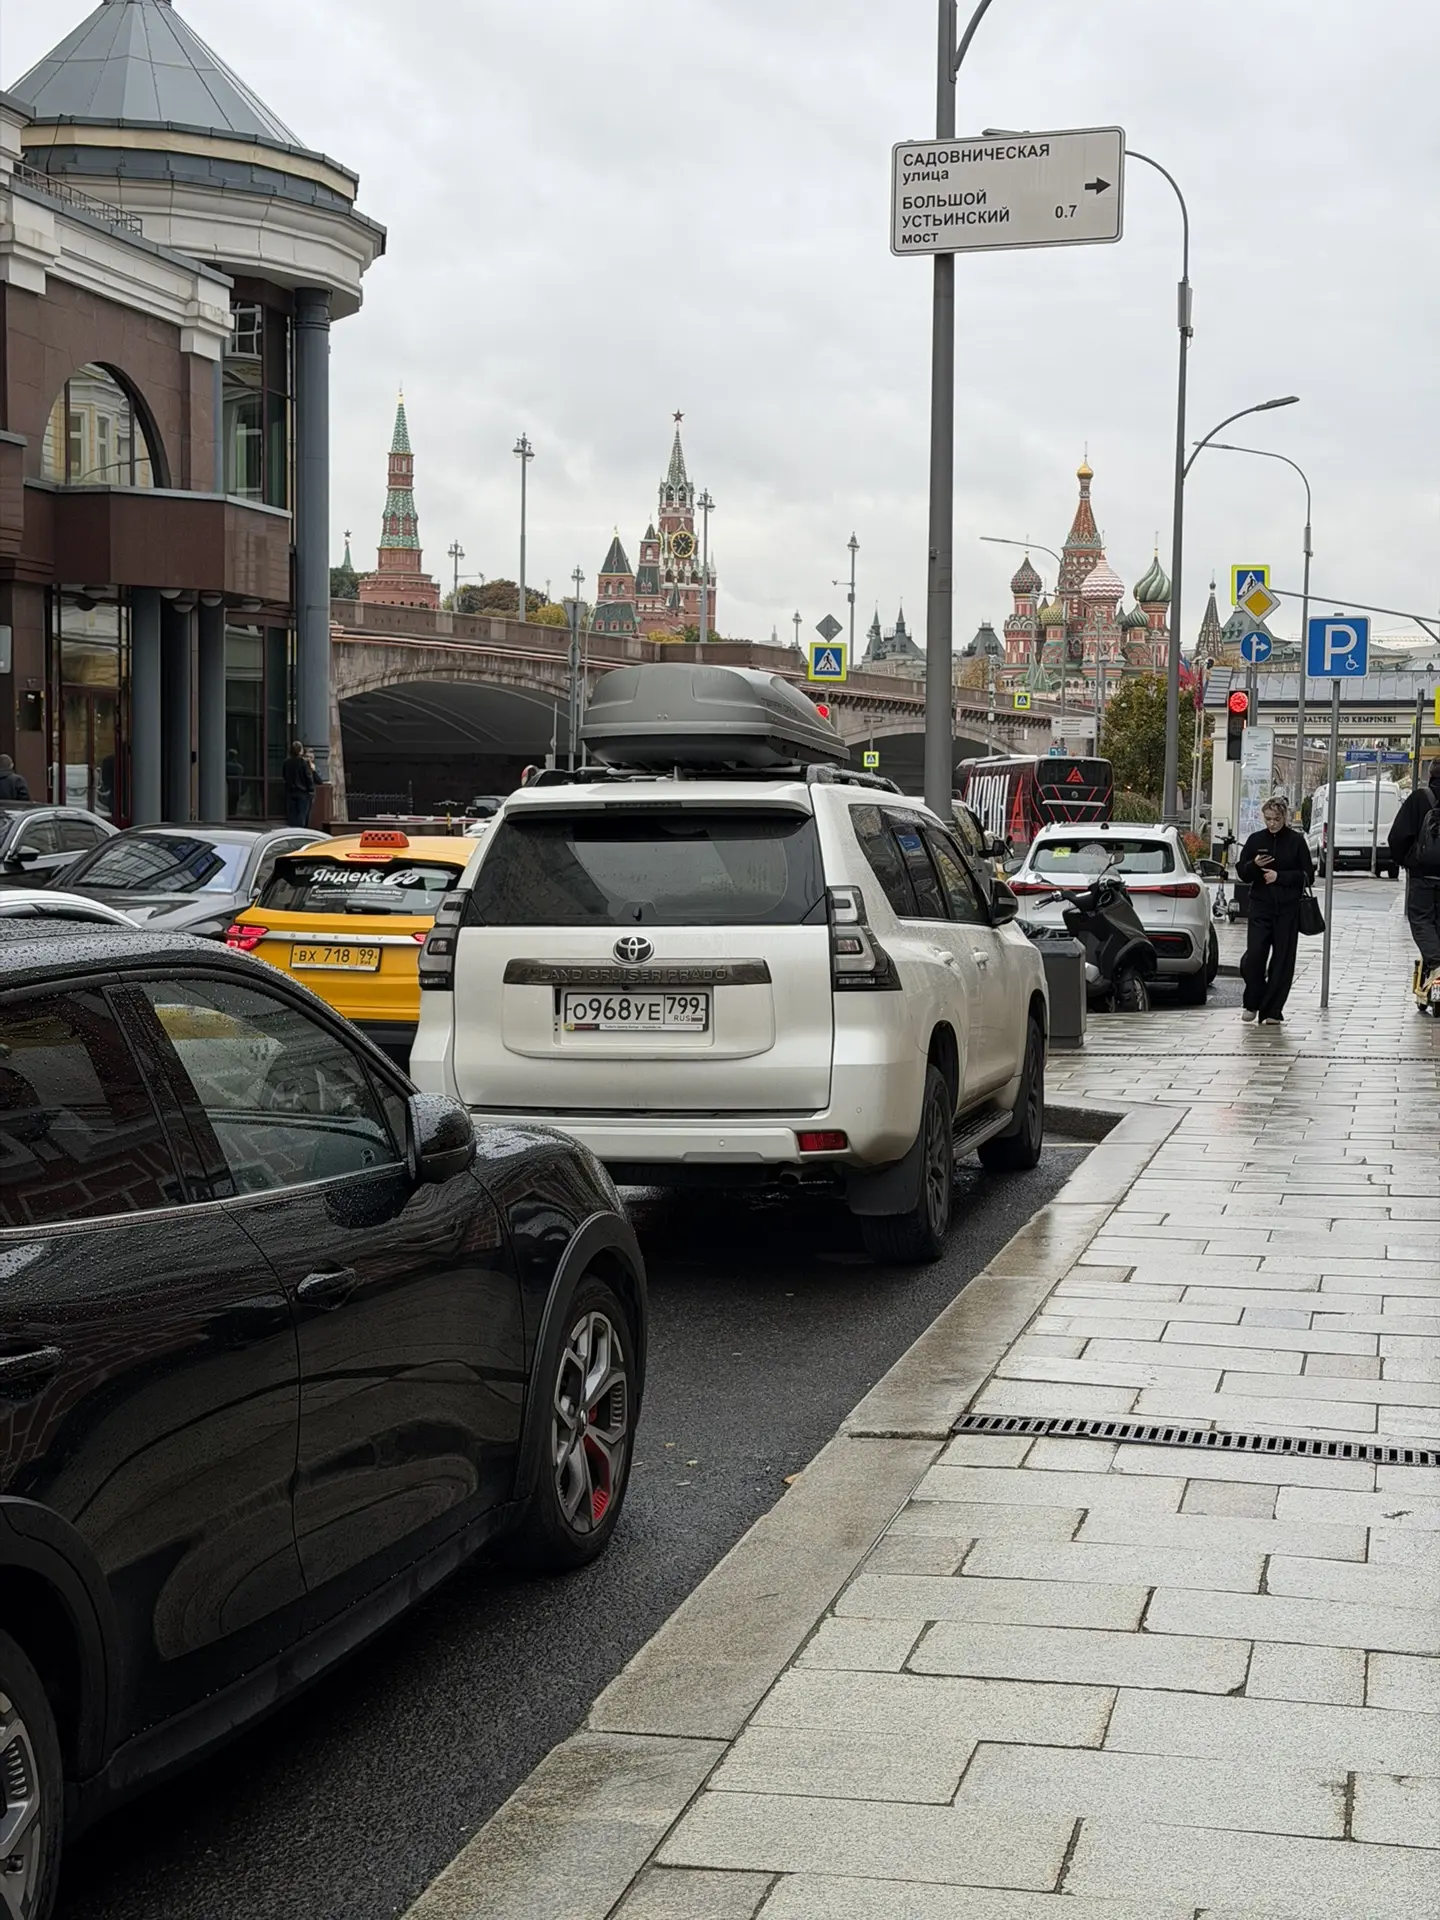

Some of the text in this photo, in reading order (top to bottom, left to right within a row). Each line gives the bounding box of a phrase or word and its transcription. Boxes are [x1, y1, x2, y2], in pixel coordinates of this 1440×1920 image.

[903, 144, 1050, 167] САДОВНИЧЕСКАЯ
[902, 169, 949, 186] улица
[902, 189, 987, 209] БОЛЬШОЙ
[902, 205, 1077, 228] УСТЬИНСКИЙ 0.7
[902, 233, 939, 244] мост
[1324, 624, 1357, 670] P
[310, 869, 420, 885] Яндекс Go
[324, 948, 350, 963] 718
[360, 949, 374, 960] 99
[541, 969, 728, 980] LAND CRUISER PRADO
[666, 997, 700, 1014] 799
